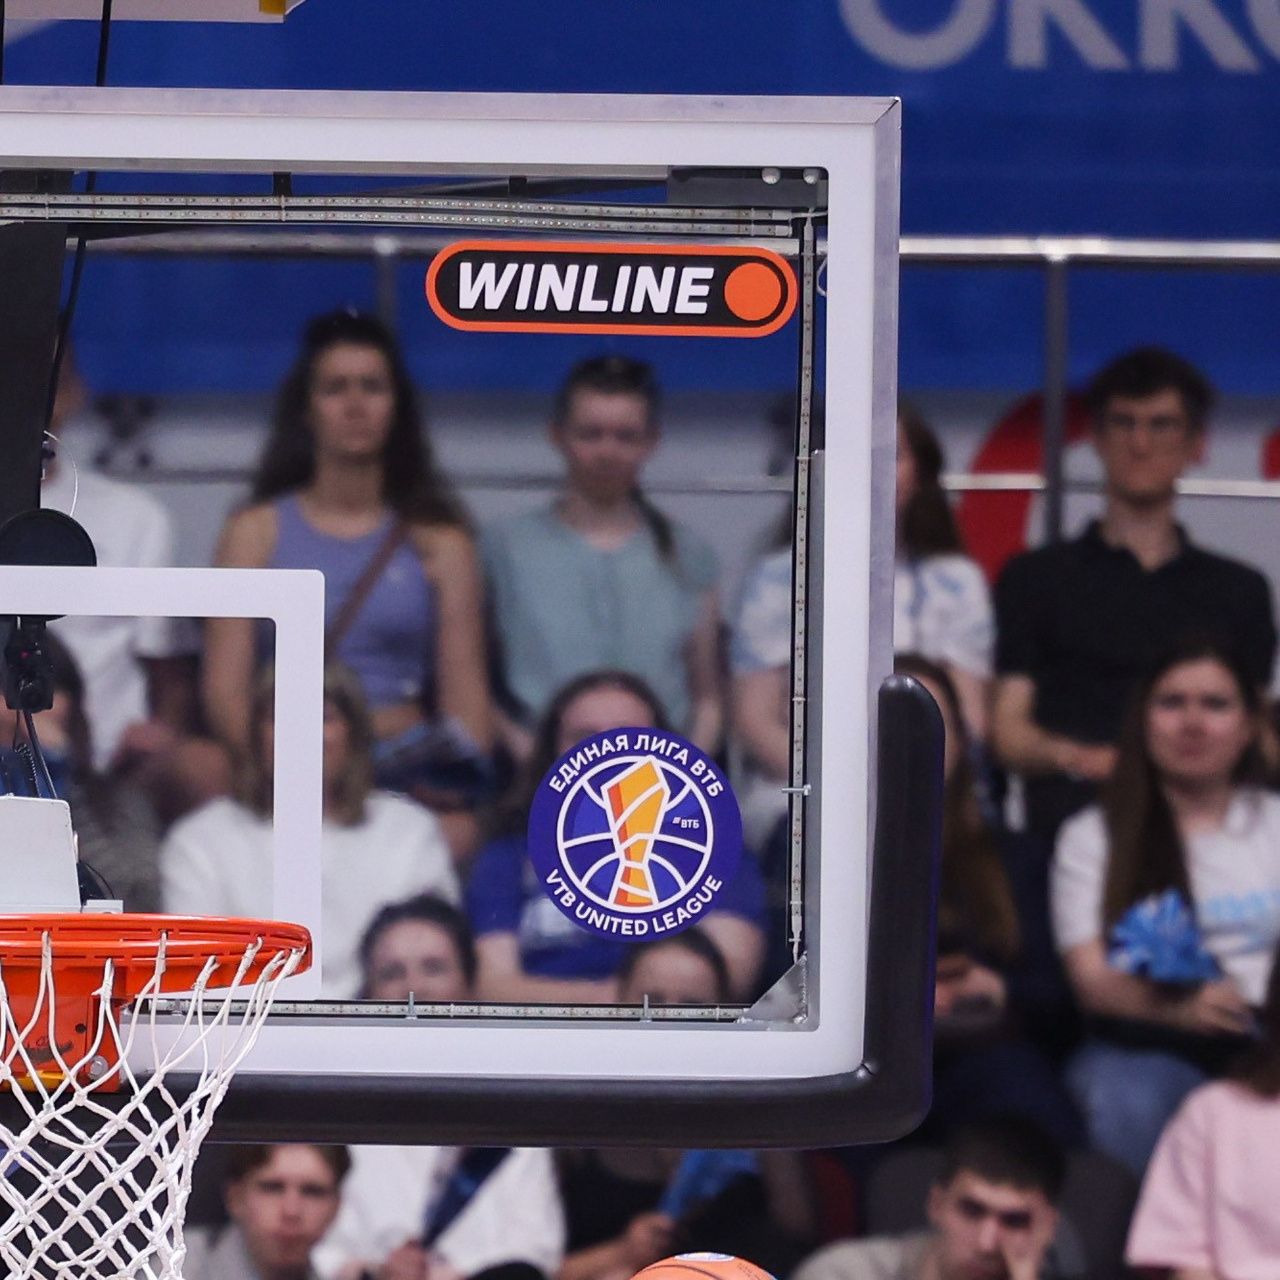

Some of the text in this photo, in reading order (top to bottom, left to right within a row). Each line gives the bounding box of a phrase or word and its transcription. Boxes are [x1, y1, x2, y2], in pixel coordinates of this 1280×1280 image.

[458, 261, 715, 315] WINLINE
[549, 734, 724, 797] ЕДИНАЯ ЛИГА ВТБ
[545, 868, 723, 936] VTB UNITED LEAGUE
